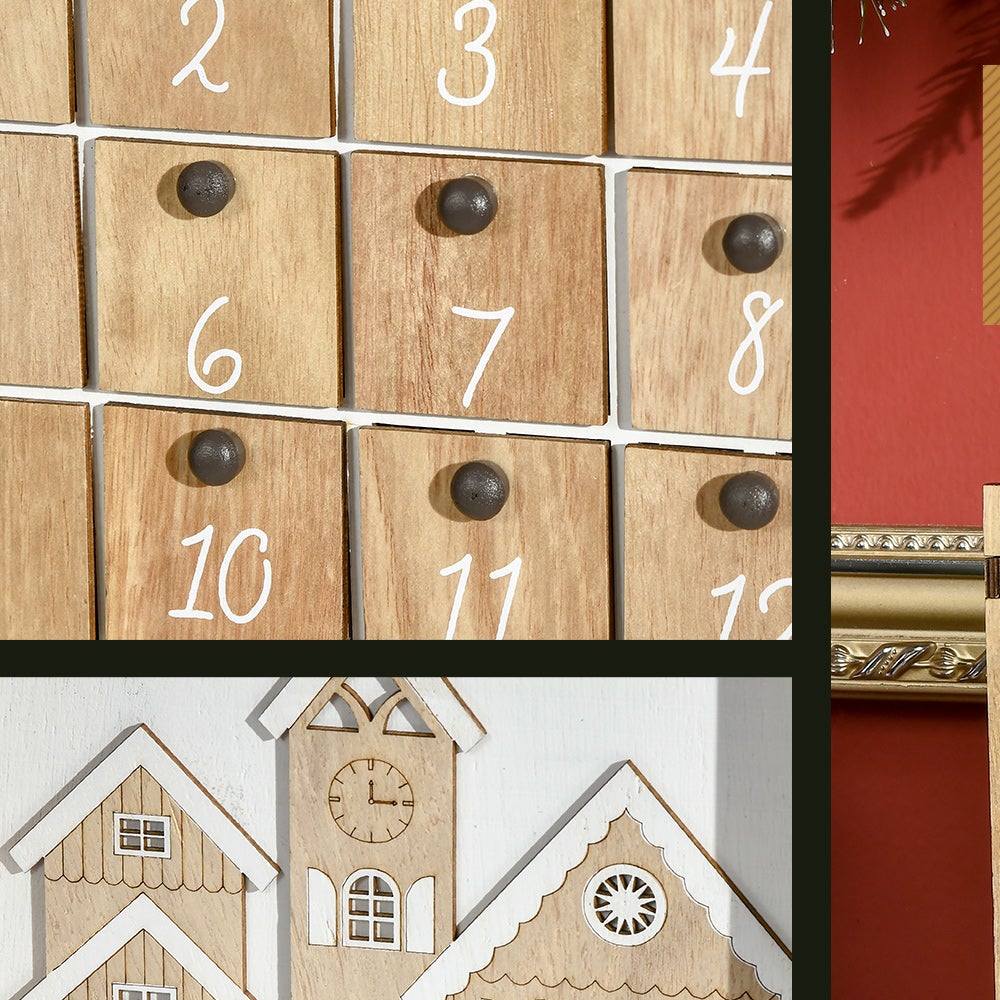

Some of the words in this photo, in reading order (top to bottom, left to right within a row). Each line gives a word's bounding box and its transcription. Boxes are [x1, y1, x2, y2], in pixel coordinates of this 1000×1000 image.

[172, 0, 229, 93] 2
[437, 0, 497, 106] 3
[710, 0, 772, 118] 4
[187, 296, 242, 395] 6
[451, 306, 515, 408] 7
[728, 291, 784, 395] 8
[168, 525, 272, 624] 10
[439, 553, 522, 640] 11
